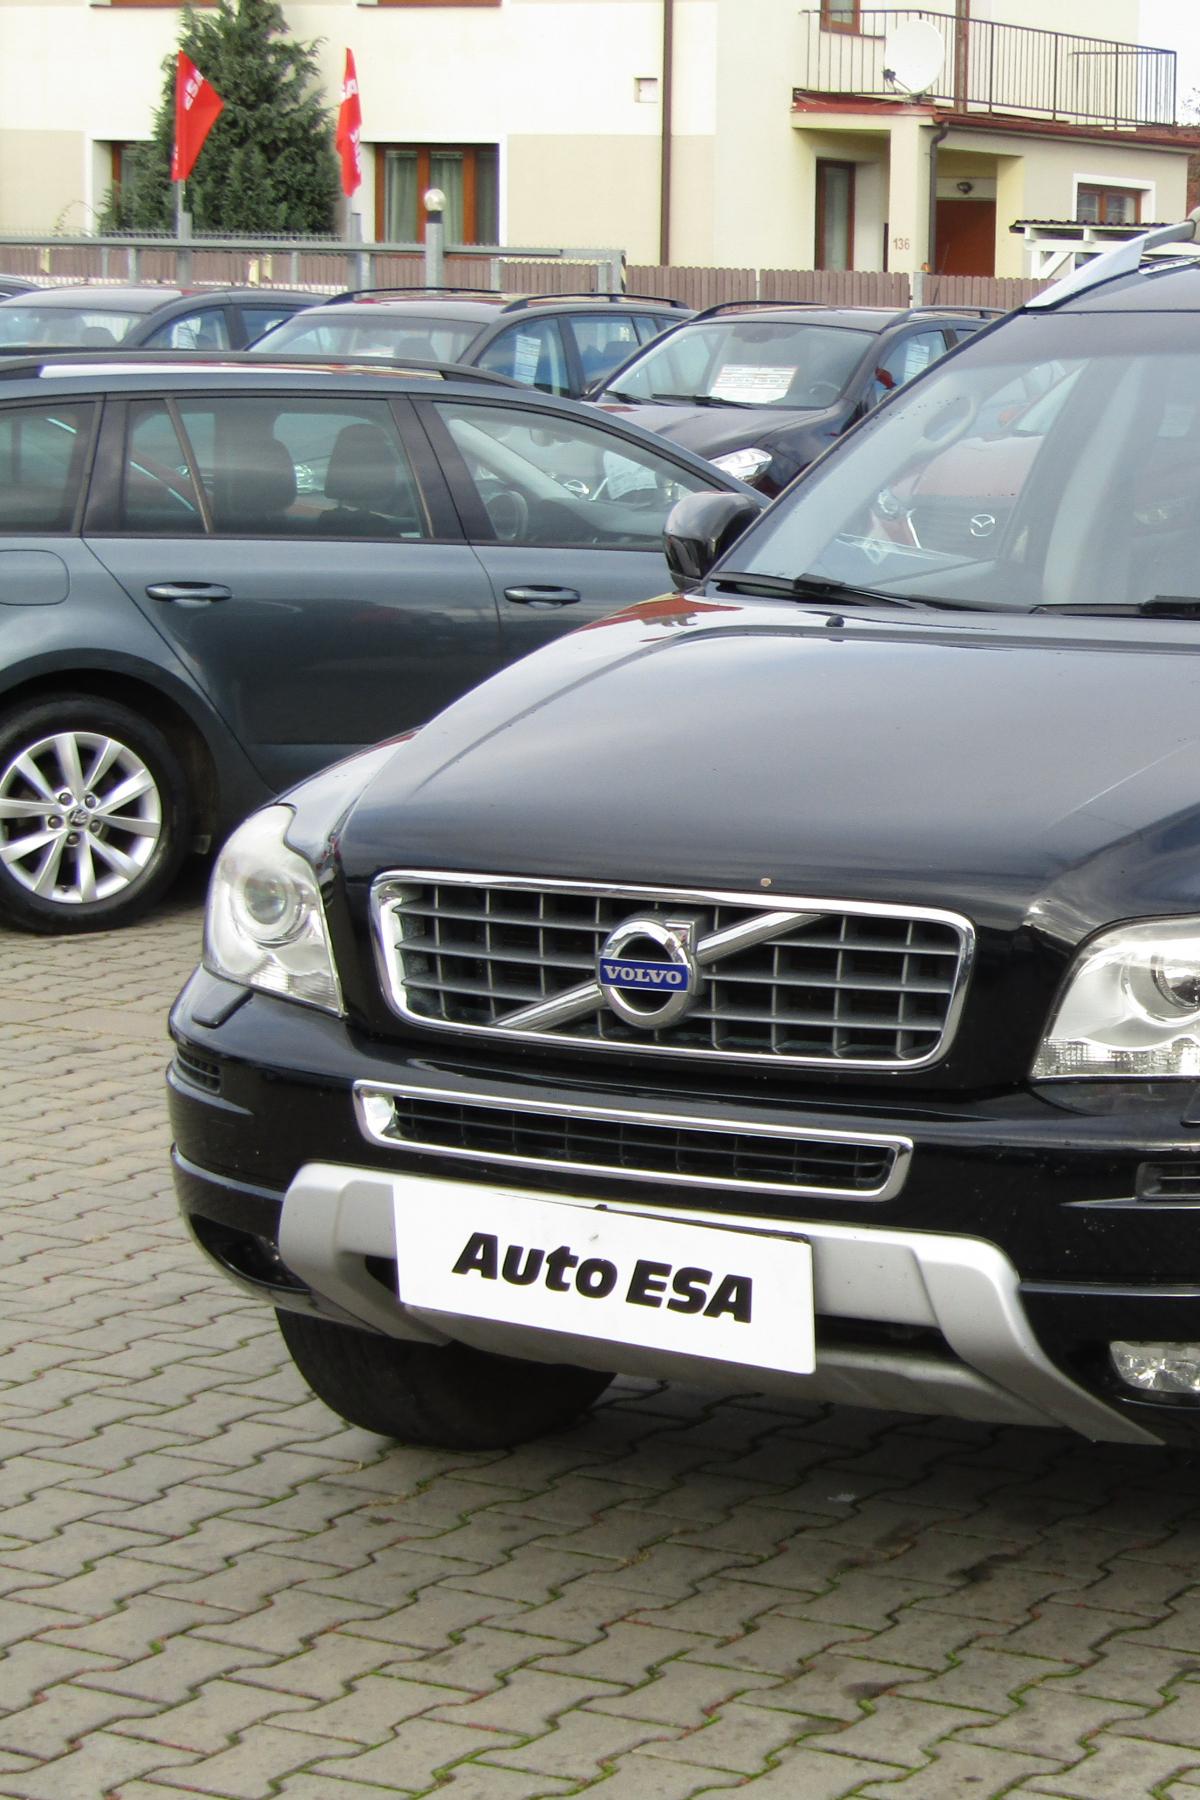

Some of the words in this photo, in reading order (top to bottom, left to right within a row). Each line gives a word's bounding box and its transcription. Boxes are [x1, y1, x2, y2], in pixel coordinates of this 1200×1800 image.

[893, 238, 910, 250] 136
[603, 965, 682, 985] VOLVO
[451, 1231, 618, 1299] Auto
[625, 1259, 753, 1324] ESA
